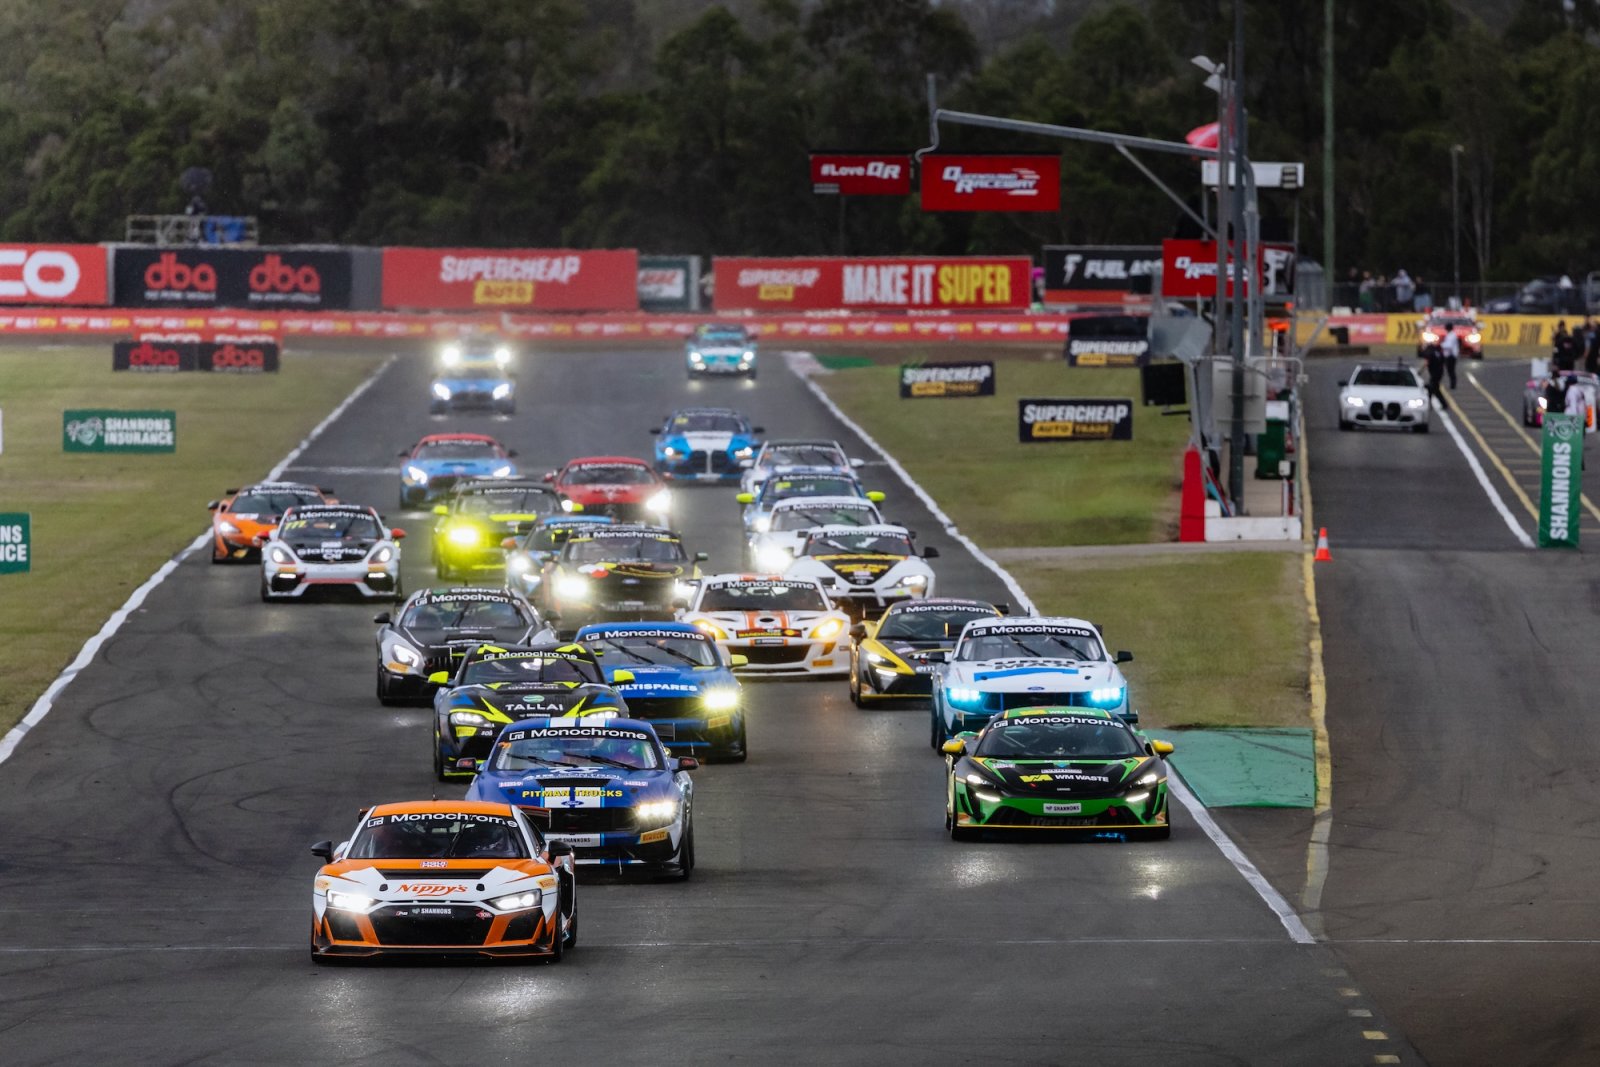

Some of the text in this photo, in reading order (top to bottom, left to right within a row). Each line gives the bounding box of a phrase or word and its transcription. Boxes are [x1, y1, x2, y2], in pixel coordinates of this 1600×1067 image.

[144, 252, 217, 290] dba
[248, 254, 320, 292] dba
[440, 256, 580, 283] SUPERCHEAP
[1084, 259, 1128, 279] FUEL
[738, 268, 820, 288] SUPERCHEAP
[842, 264, 1011, 304] MAKE IT SUPER
[483, 286, 528, 299] AUTO
[1070, 340, 1149, 355] SUPERCHEAP
[129, 345, 180, 365] dba
[212, 345, 264, 367] dba
[903, 365, 991, 384] SUPERCHEAP
[1023, 403, 1128, 424] SUPERCHEAP
[104, 417, 171, 431] SHANNONS
[1037, 423, 1110, 434] AUTO TRADE
[104, 431, 174, 445] INSURANCE
[1550, 442, 1572, 540] SHANNONS
[793, 502, 869, 512] Monochrome
[300, 511, 374, 521] Monochrome
[592, 531, 670, 539] Monochrome
[828, 530, 908, 540] Monochrome
[727, 582, 816, 590] Monochrome
[905, 604, 997, 615] Monochrome
[604, 630, 705, 641] Monochrome
[991, 625, 1091, 637] Monochrome
[498, 651, 578, 660] Monochrome
[1014, 716, 1124, 728] Monochrome
[530, 728, 648, 740] Monochrome
[1075, 774, 1109, 782] WASTE
[522, 789, 623, 798] PITMAN TRUCKS
[391, 812, 518, 828] Monochrome
[393, 883, 468, 897] Nippy's
